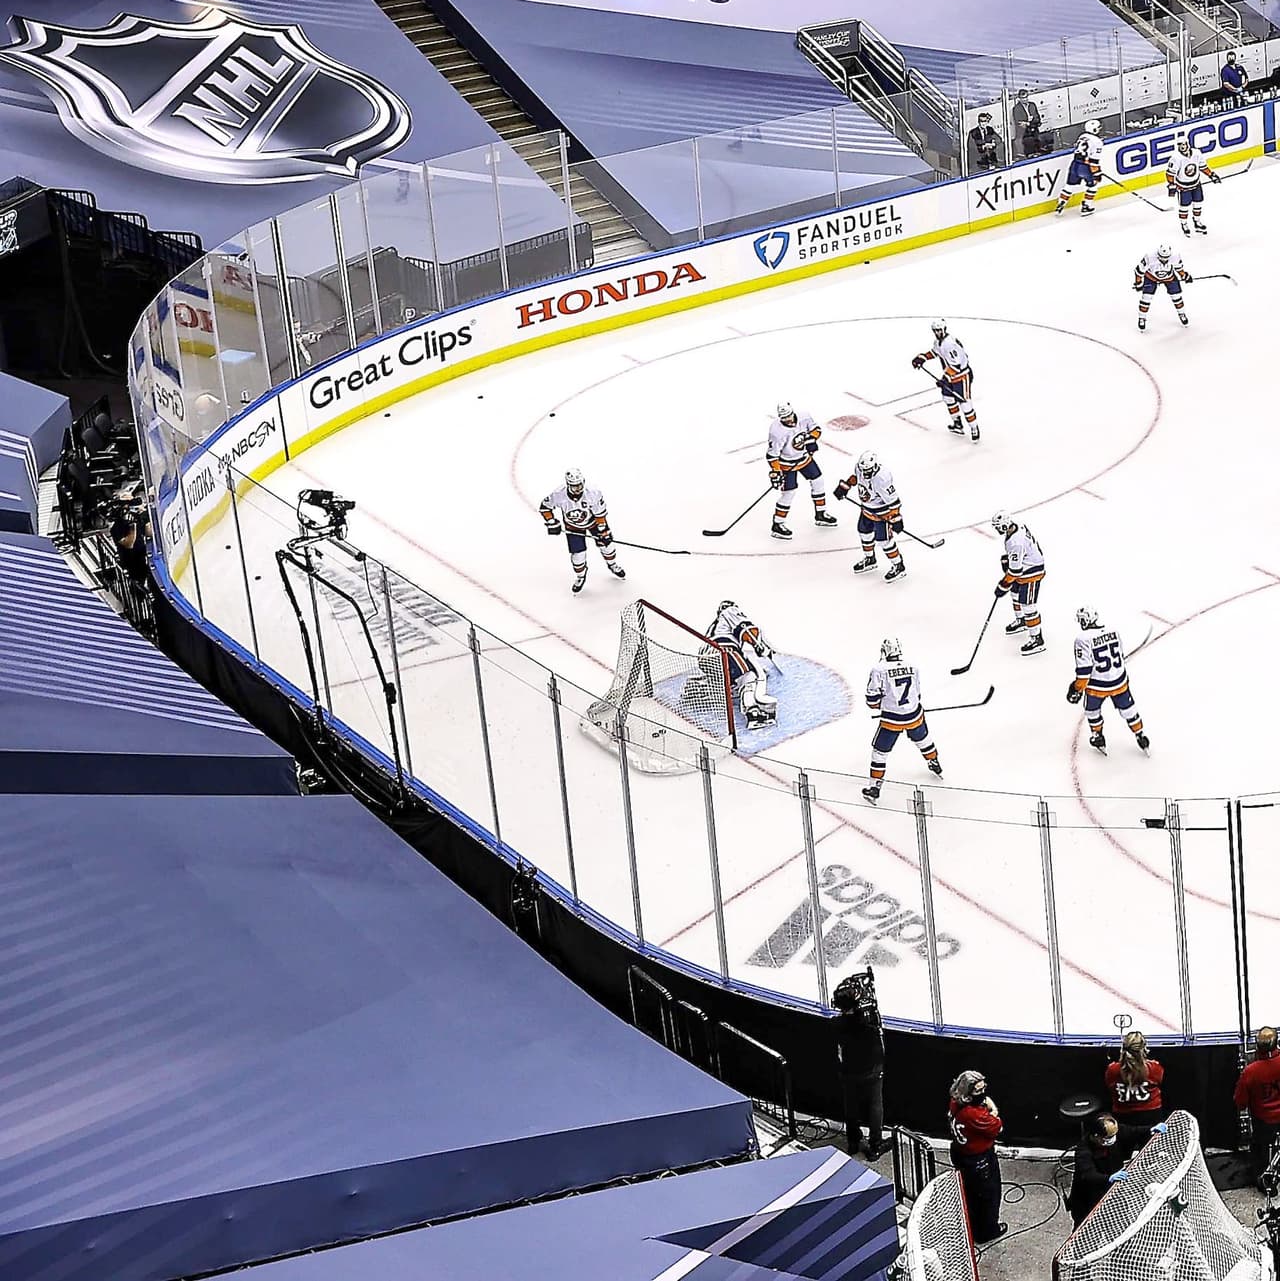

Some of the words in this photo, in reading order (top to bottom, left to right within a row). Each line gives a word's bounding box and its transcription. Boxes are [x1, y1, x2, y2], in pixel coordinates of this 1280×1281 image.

[172, 45, 294, 147] NHL
[1116, 116, 1248, 175] GECO
[975, 168, 1061, 213] xfinity
[797, 204, 902, 246] FANDUEL
[799, 223, 904, 260] SPORTSBOOK
[515, 261, 706, 329] HONDA
[310, 356, 393, 410] Great
[398, 322, 474, 368] Clips
[231, 417, 276, 463] NBCSN
[186, 467, 215, 511] VODKA
[887, 666, 915, 679] EBERLE
[1093, 641, 1122, 673] 55
[894, 677, 912, 706] 7
[818, 863, 962, 961] adidas
[1115, 1081, 1150, 1103] EMS
